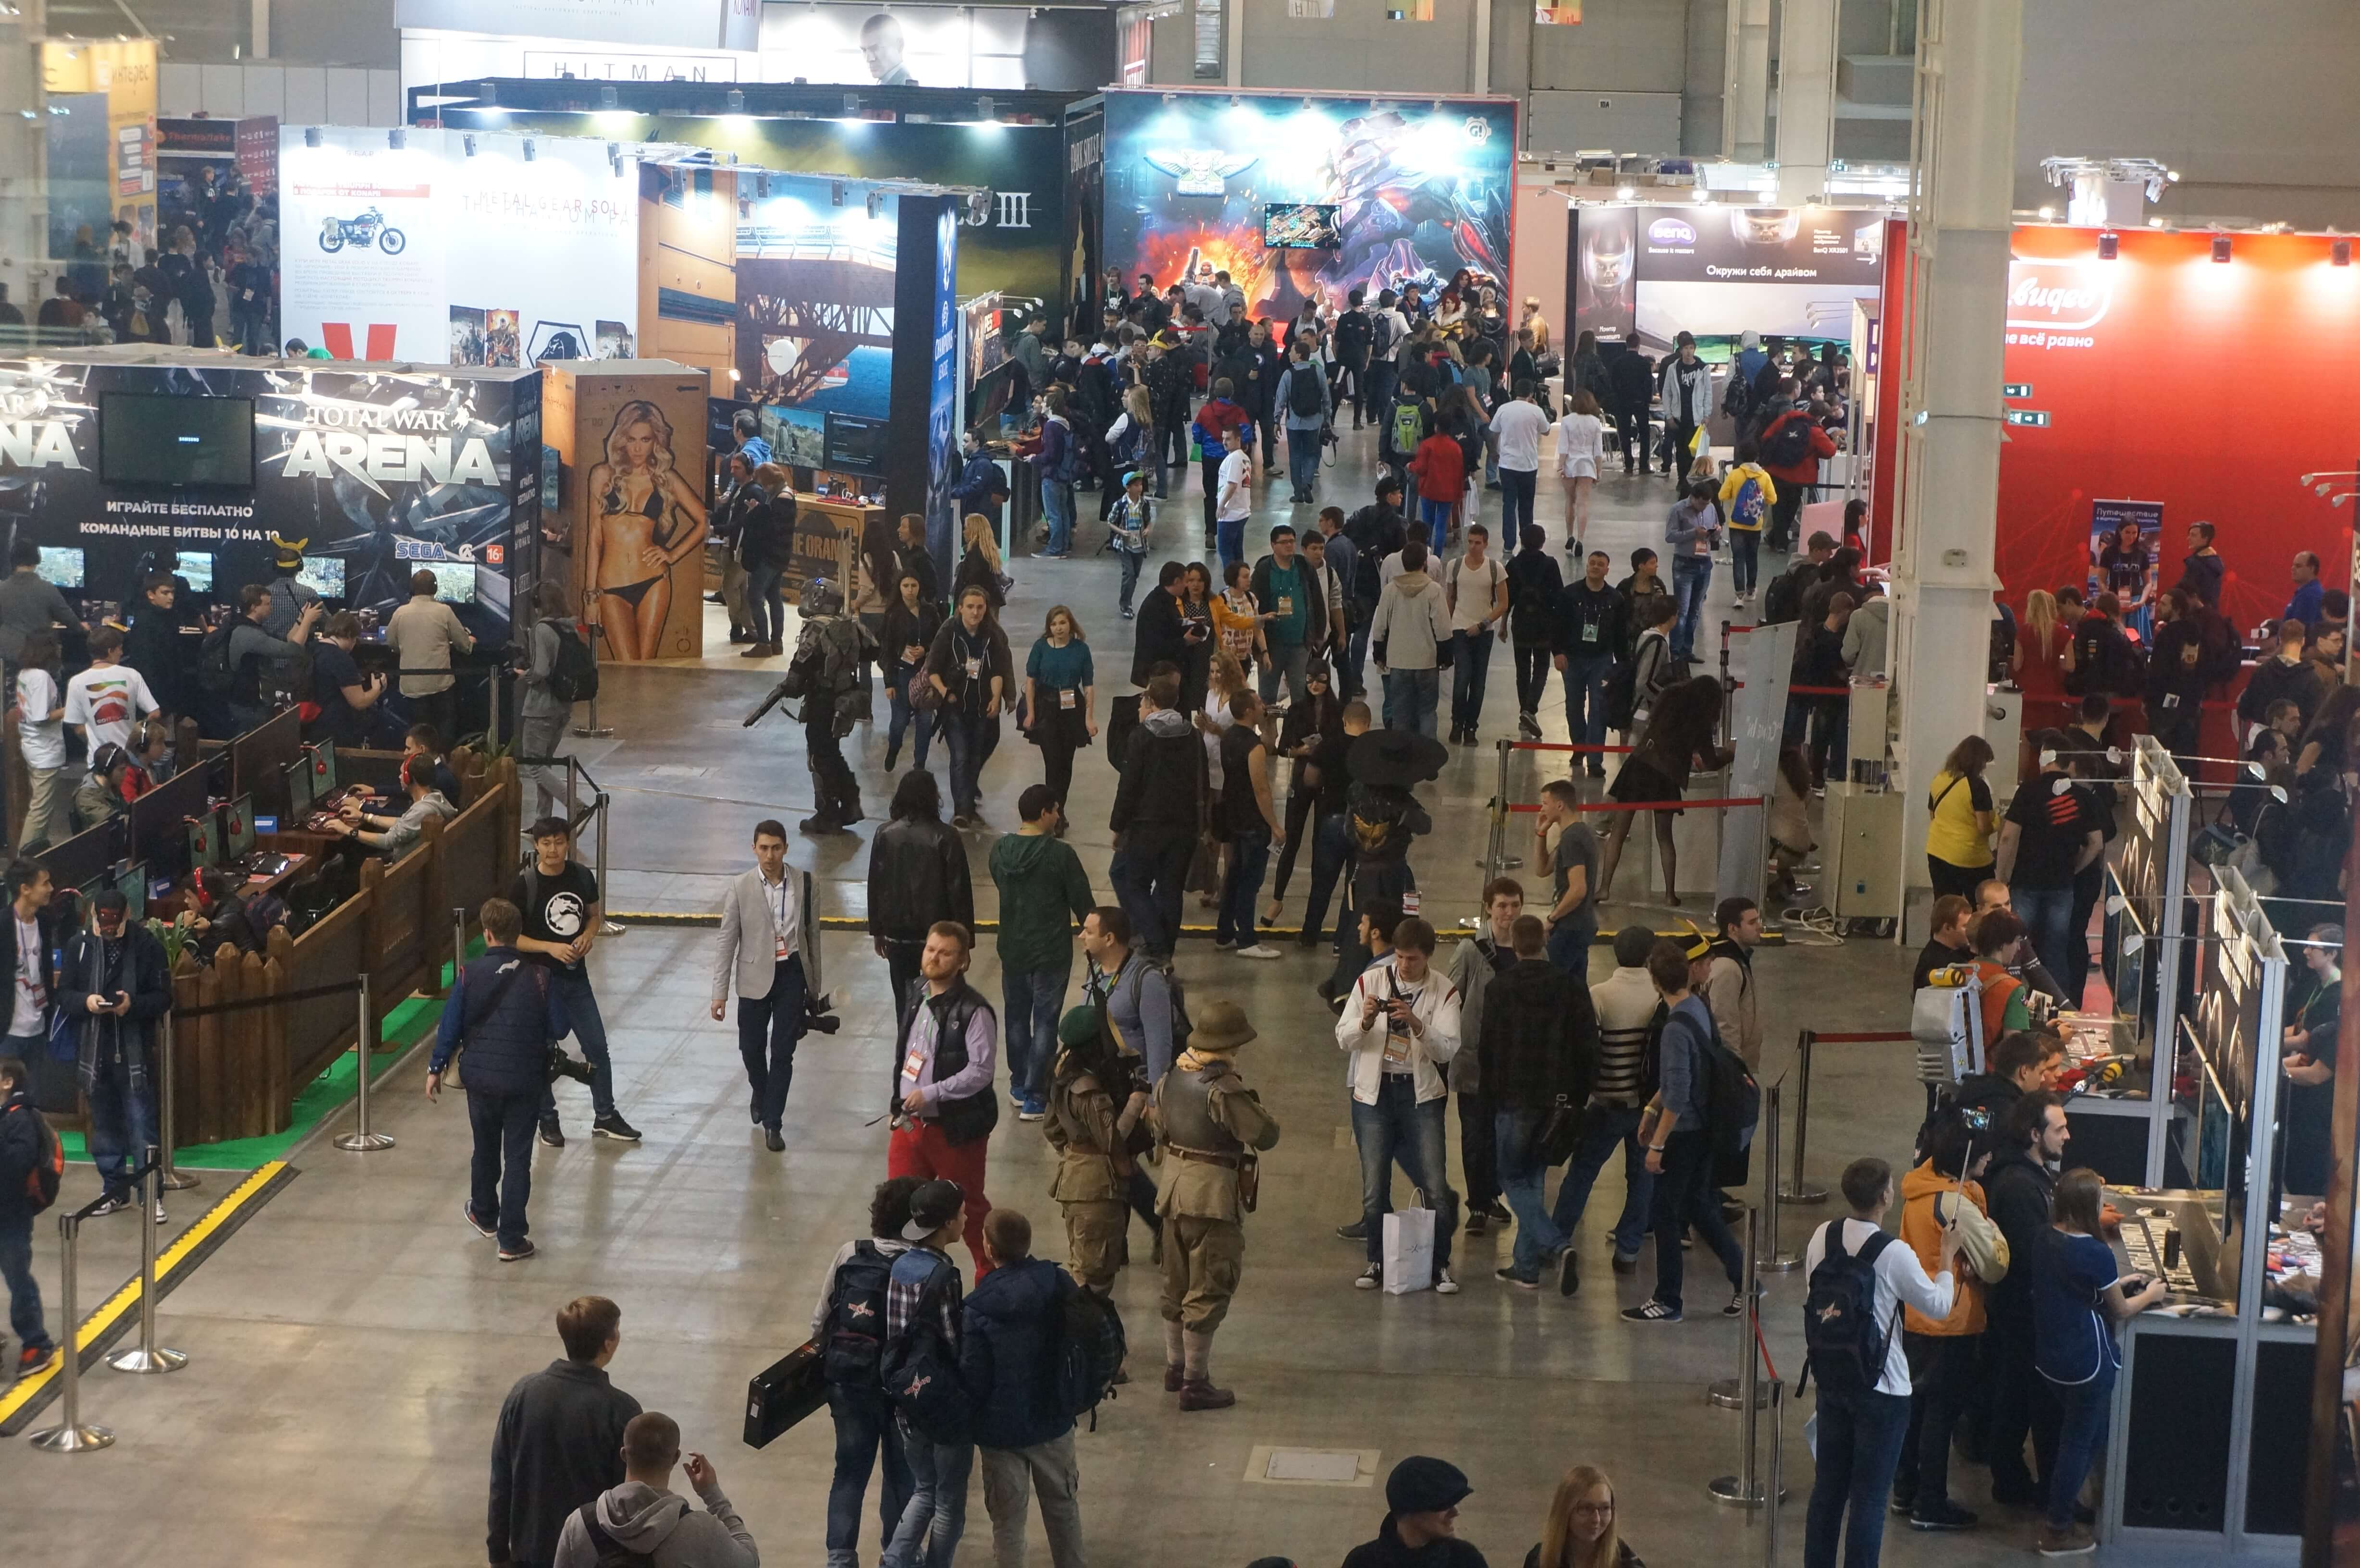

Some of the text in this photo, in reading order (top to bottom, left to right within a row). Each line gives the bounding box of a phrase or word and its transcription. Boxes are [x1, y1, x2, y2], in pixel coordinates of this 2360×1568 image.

[554, 62, 706, 83] HITMAN
[996, 192, 1032, 227] III
[1654, 227, 1692, 241] BenQ
[1706, 265, 1817, 279] Окружи себя драйвом
[2007, 277, 2093, 315] .видео
[2019, 332, 2045, 346] всё
[2046, 336, 2094, 350] равно
[304, 406, 450, 431] TOTAL WAR
[282, 431, 501, 501] ARENA
[106, 500, 254, 518] ИГРАЙТЕ БЕСПЛАТНО
[80, 522, 280, 542] КОМАНДНЫЕ БИТВЫ 10 НА 10
[395, 541, 447, 561] SEGA
[487, 548, 503, 561] 16+
[805, 534, 856, 565] ORANE
